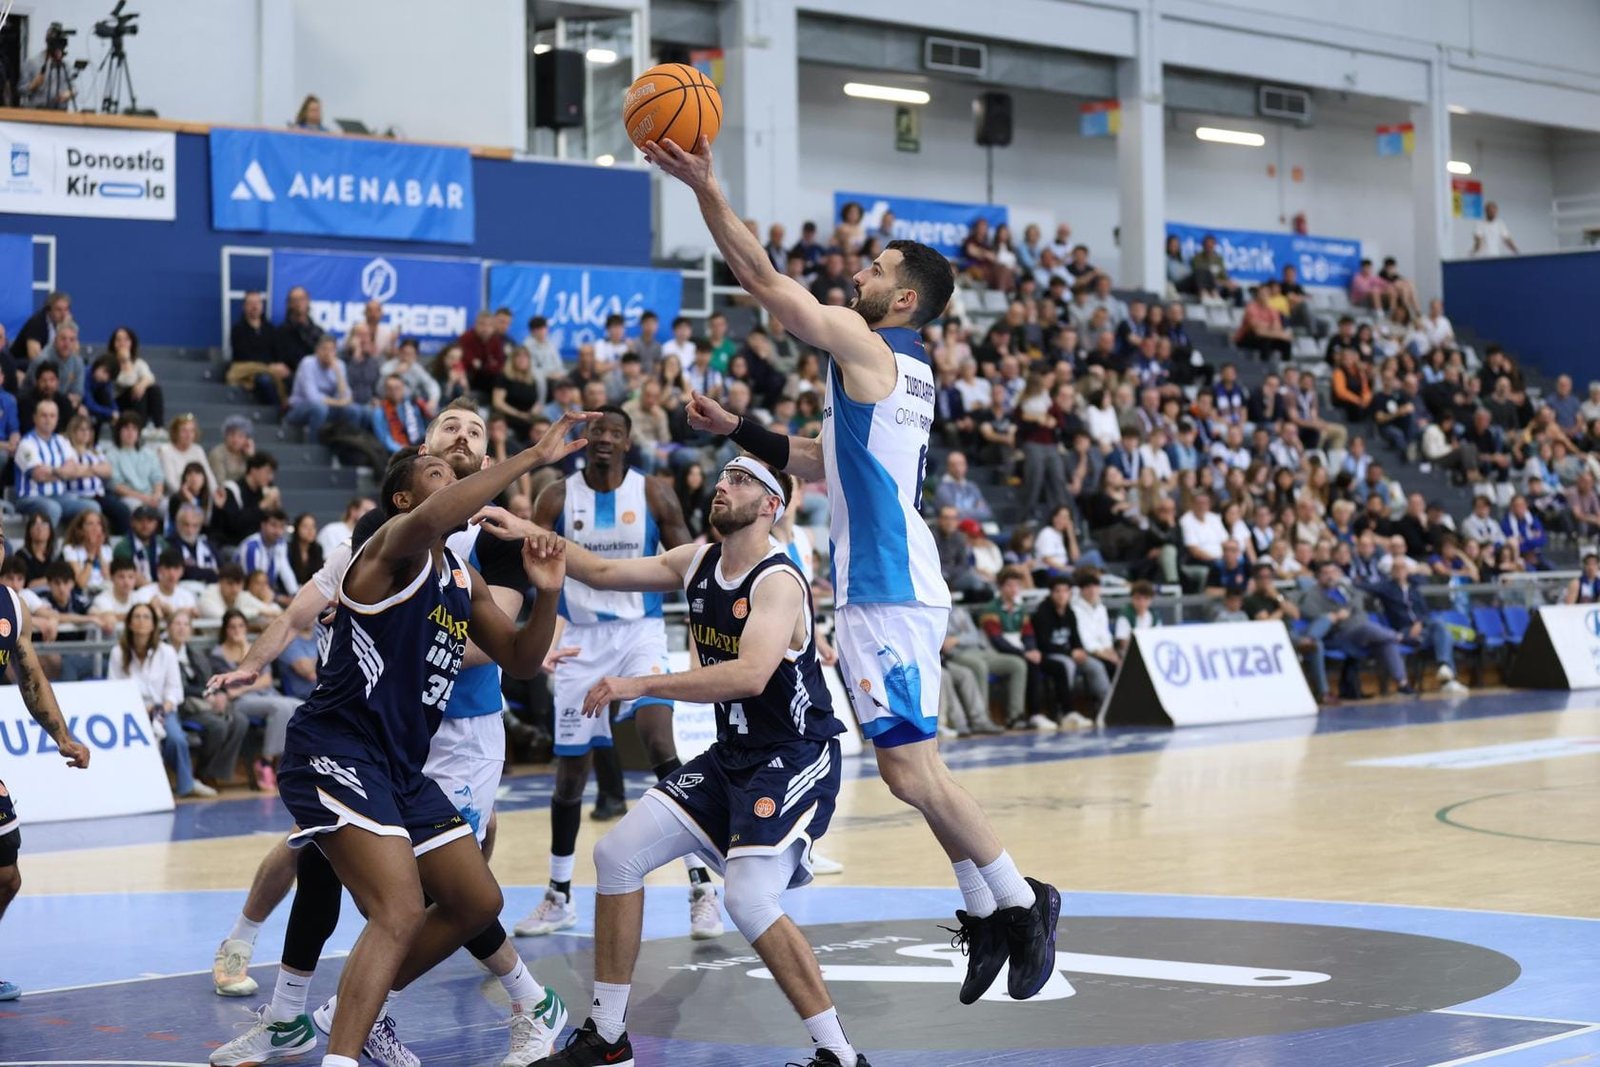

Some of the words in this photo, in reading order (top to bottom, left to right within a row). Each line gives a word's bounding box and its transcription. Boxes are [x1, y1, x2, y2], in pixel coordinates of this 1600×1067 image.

[67, 148, 165, 171] Donostia
[288, 172, 464, 210] AMENABAR
[583, 541, 639, 552] Naturklima
